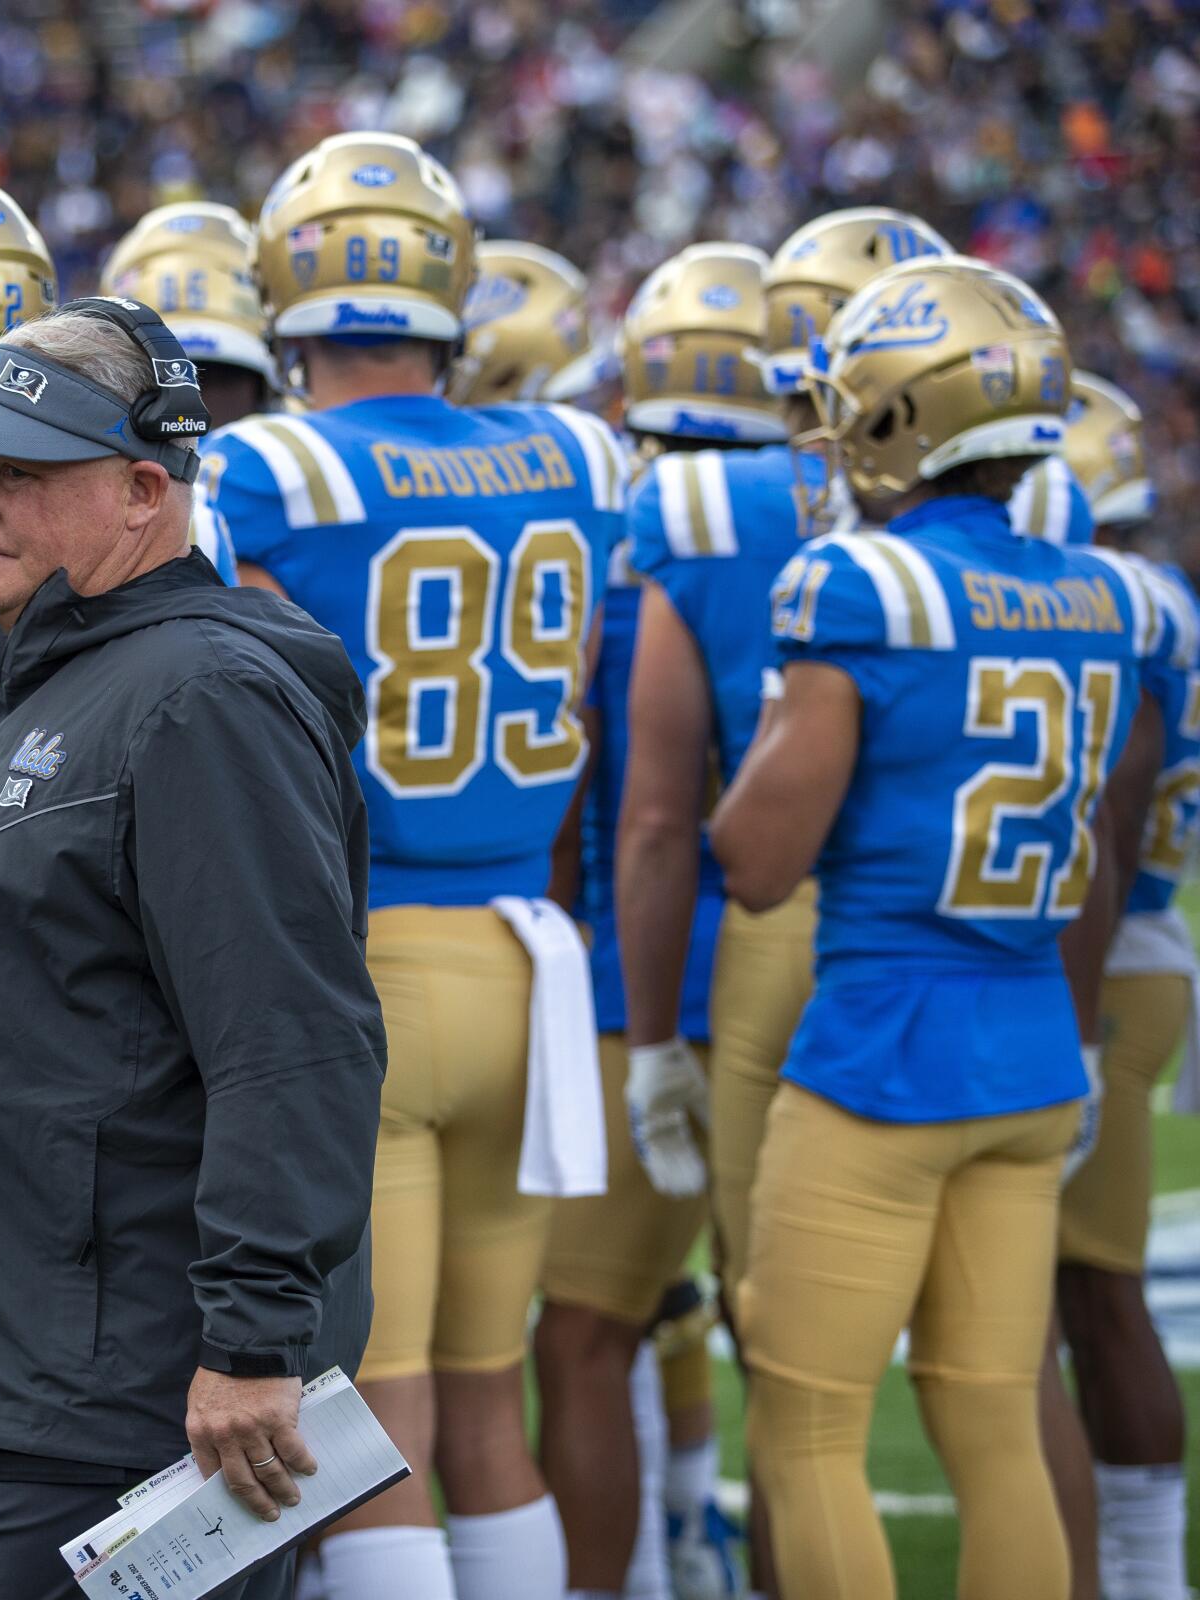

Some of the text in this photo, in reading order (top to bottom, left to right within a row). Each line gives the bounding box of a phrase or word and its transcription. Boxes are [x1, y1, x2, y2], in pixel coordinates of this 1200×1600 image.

[346, 235, 400, 282] 89
[161, 415, 206, 433] nextiva
[371, 434, 576, 499] CHURICH
[770, 554, 832, 643] 21
[365, 519, 592, 800] 89
[942, 657, 1119, 919] 21
[134, 1487, 147, 1498] DN
[108, 1531, 137, 1554] OPENERS
[127, 1562, 139, 1575] 2022
[118, 1584, 130, 1594] VS
[139, 1579, 160, 1600] ECEMBER
